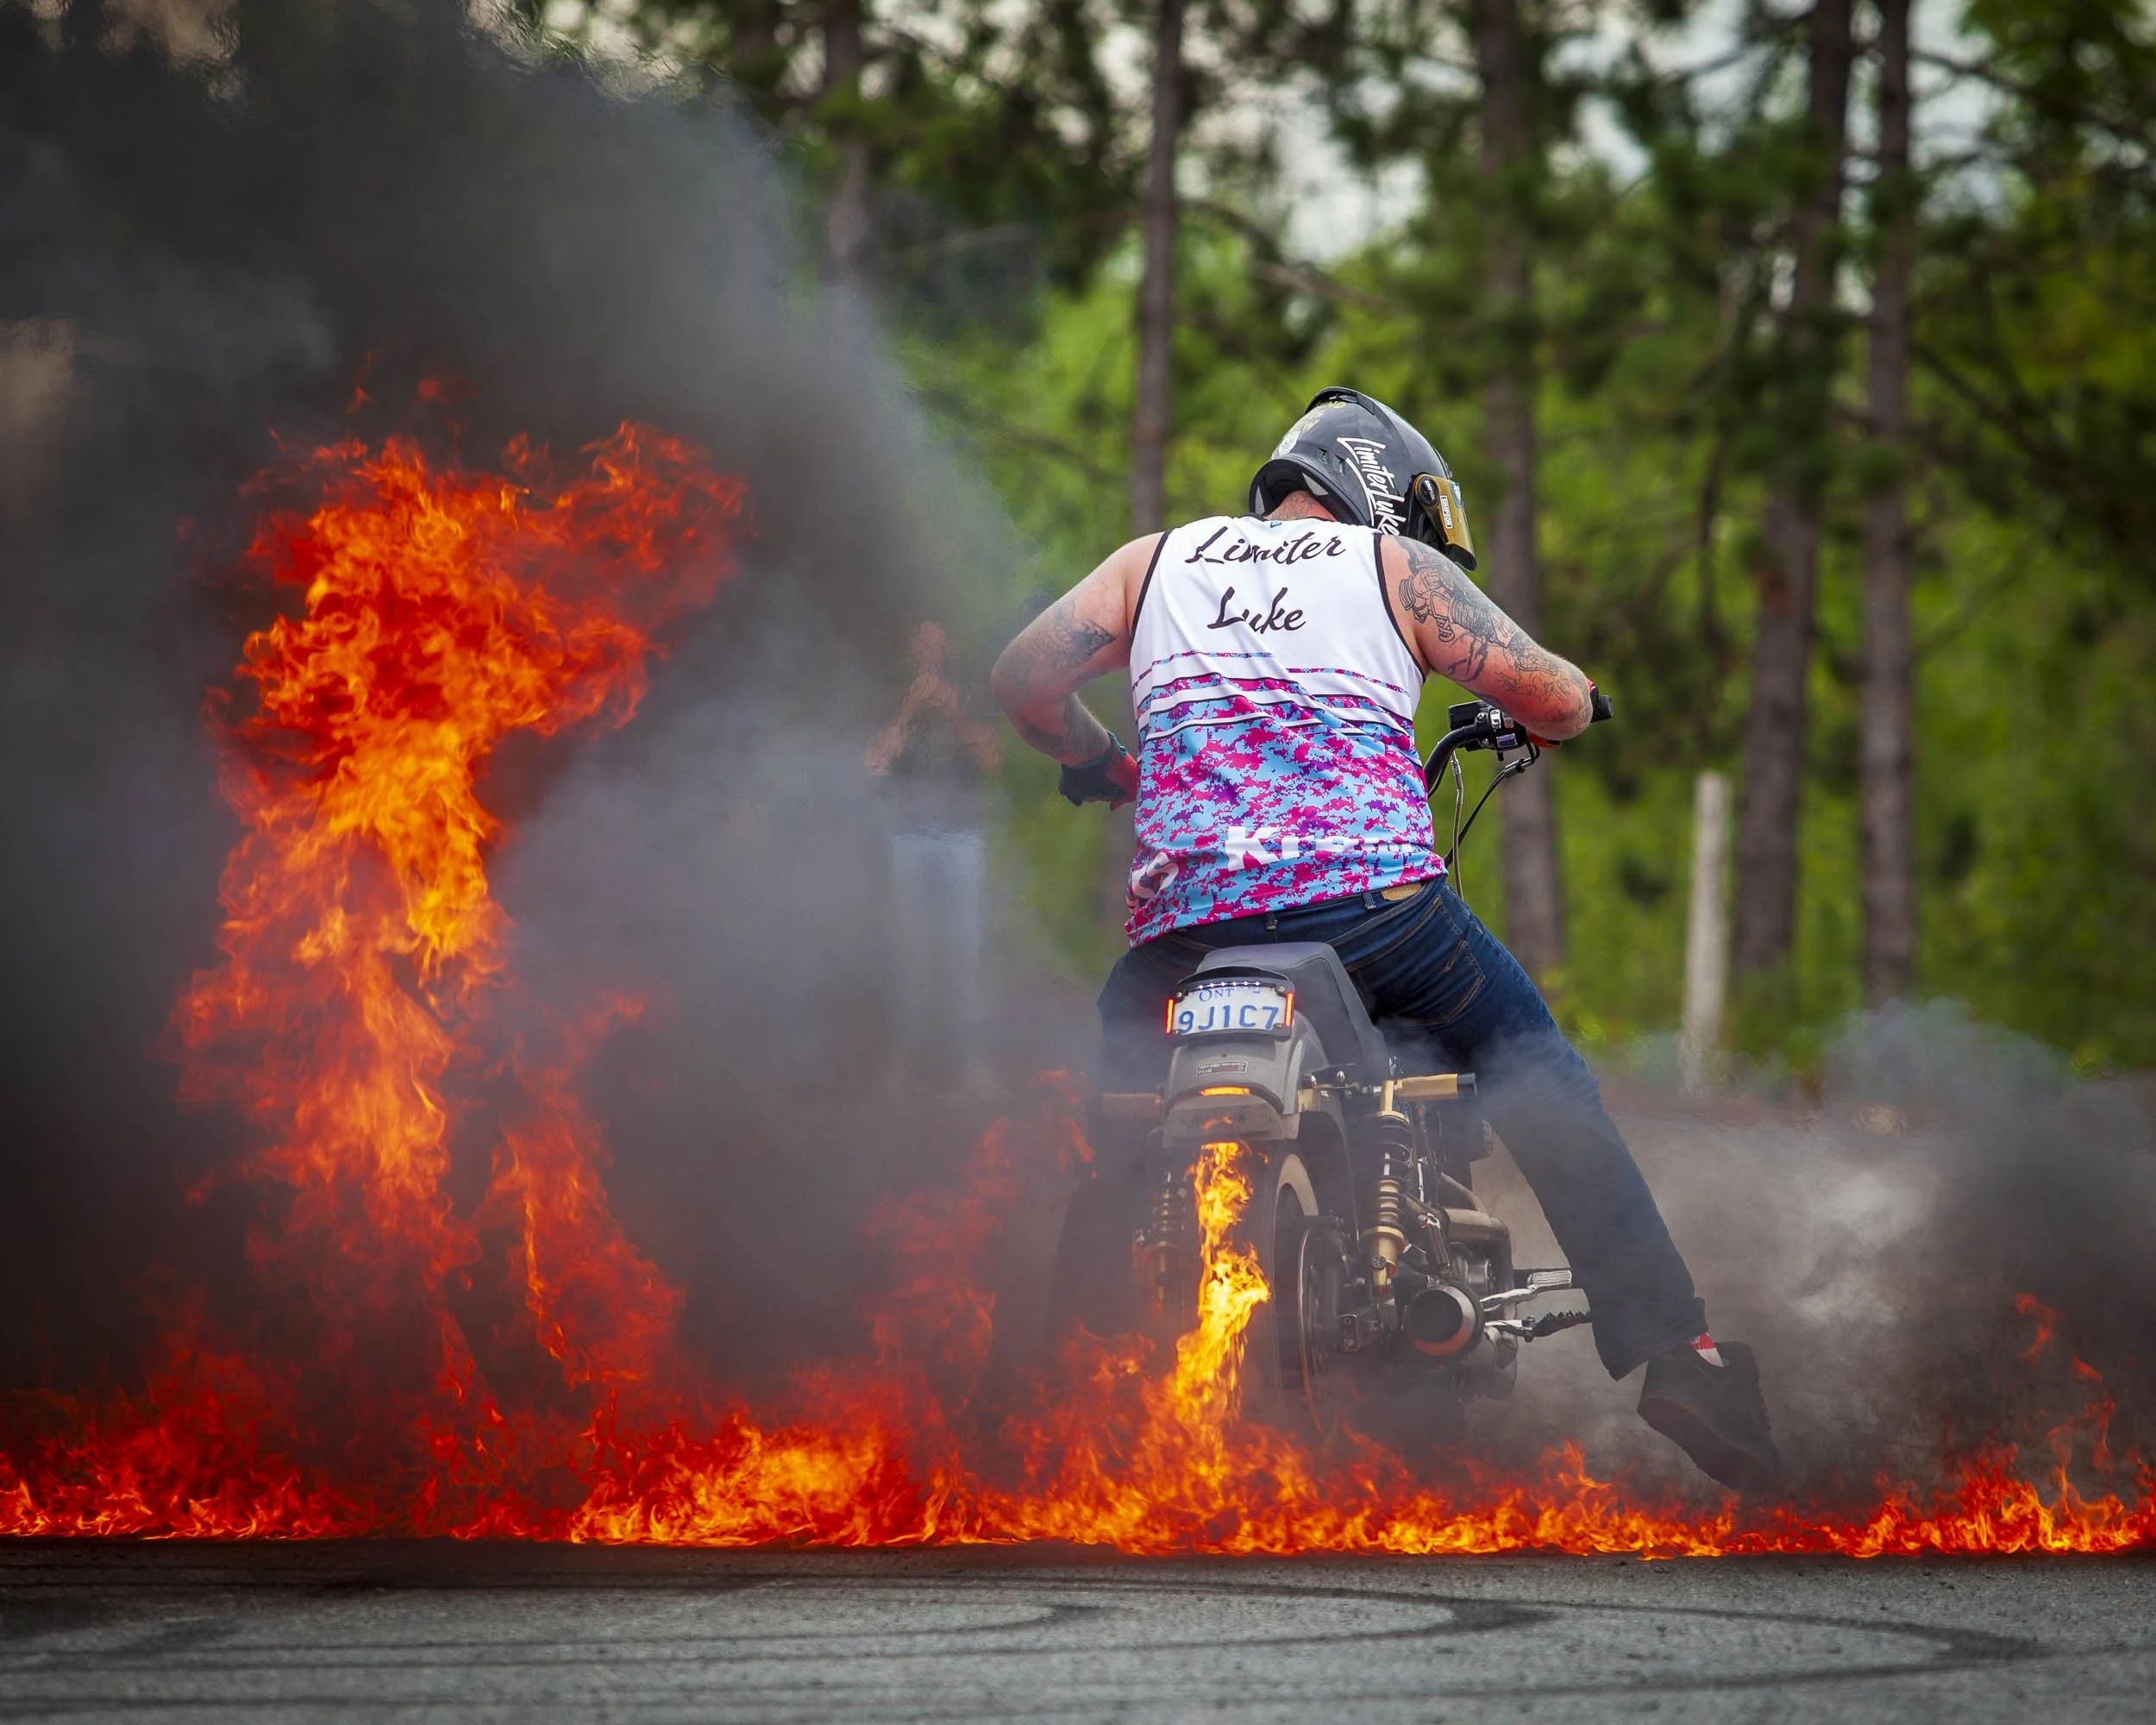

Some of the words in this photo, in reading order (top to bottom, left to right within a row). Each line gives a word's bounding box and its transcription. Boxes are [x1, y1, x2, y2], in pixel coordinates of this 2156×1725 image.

[1185, 526, 1345, 565] Limiter
[1207, 586, 1306, 634] Luke
[1200, 988, 1234, 1001] ONT
[1179, 1005, 1279, 1034] 9J1C7
